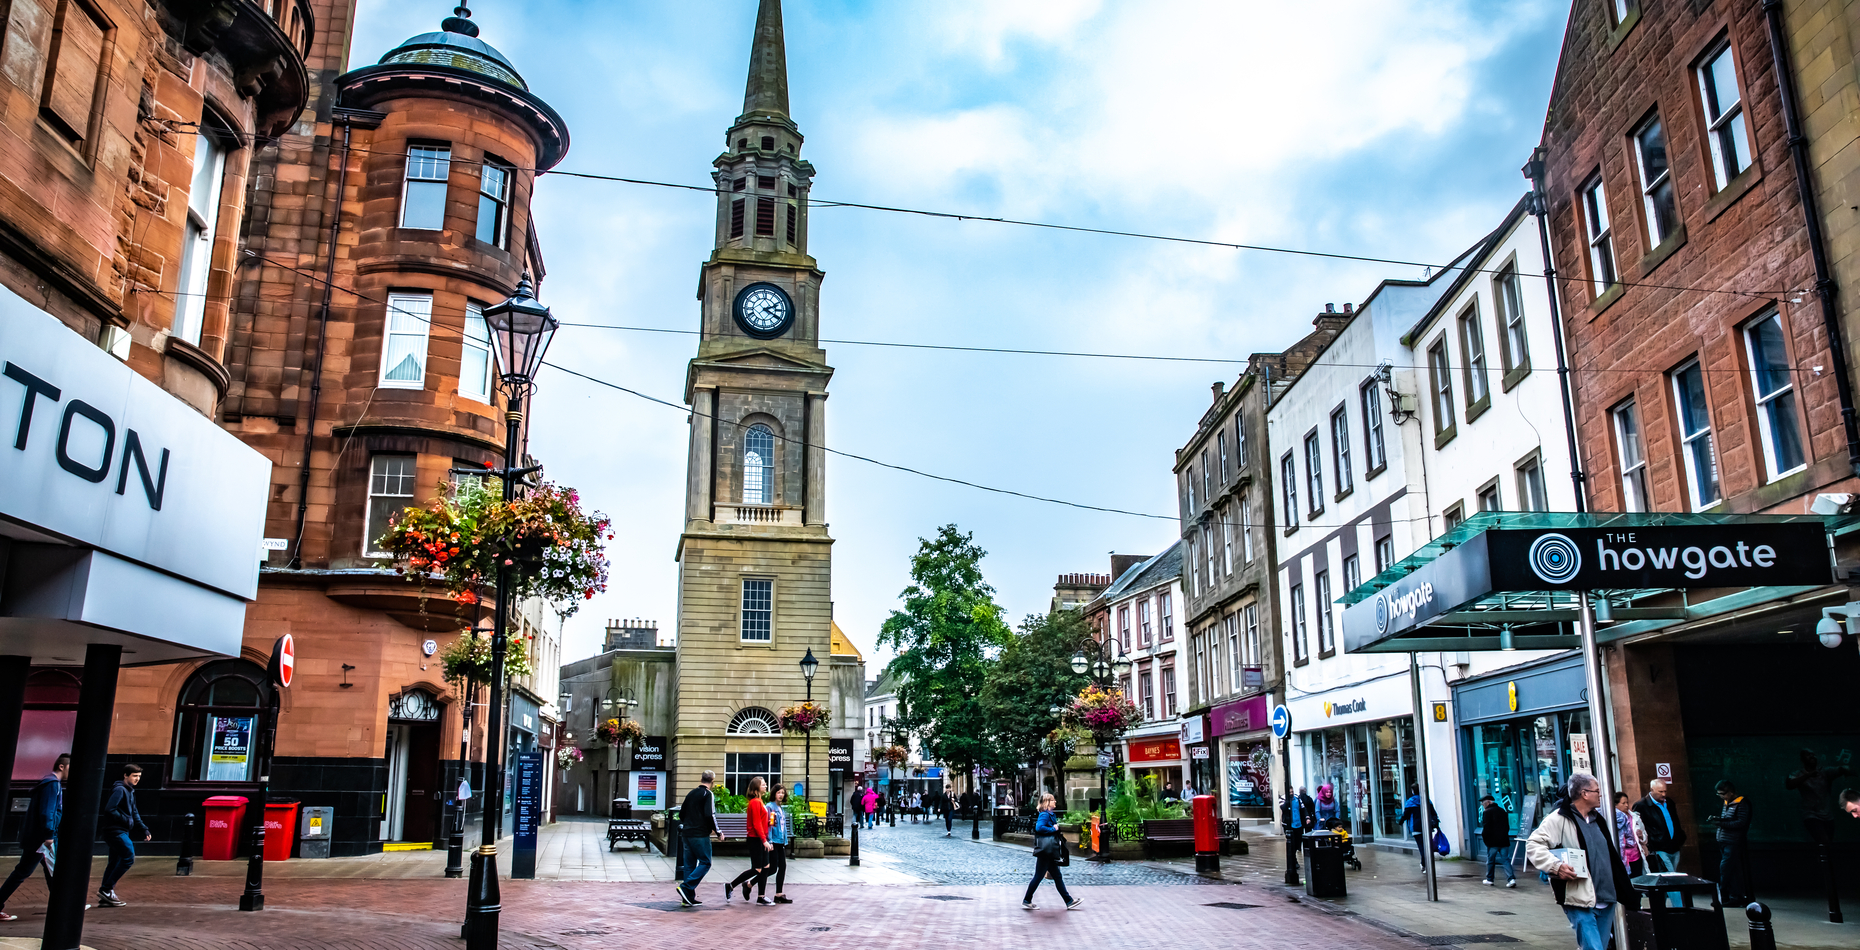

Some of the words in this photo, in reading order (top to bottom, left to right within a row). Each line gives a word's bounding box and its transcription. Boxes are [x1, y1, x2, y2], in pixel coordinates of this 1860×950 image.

[3, 360, 170, 511] TON
[1606, 532, 1637, 543] THE
[1596, 538, 1777, 580] howgate
[1388, 582, 1434, 620] howgate
[1332, 703, 1352, 716] Thomas
[1352, 697, 1367, 713] Cook
[223, 736, 239, 747] 50
[1573, 740, 1586, 753] SALE
[828, 747, 848, 755] vision
